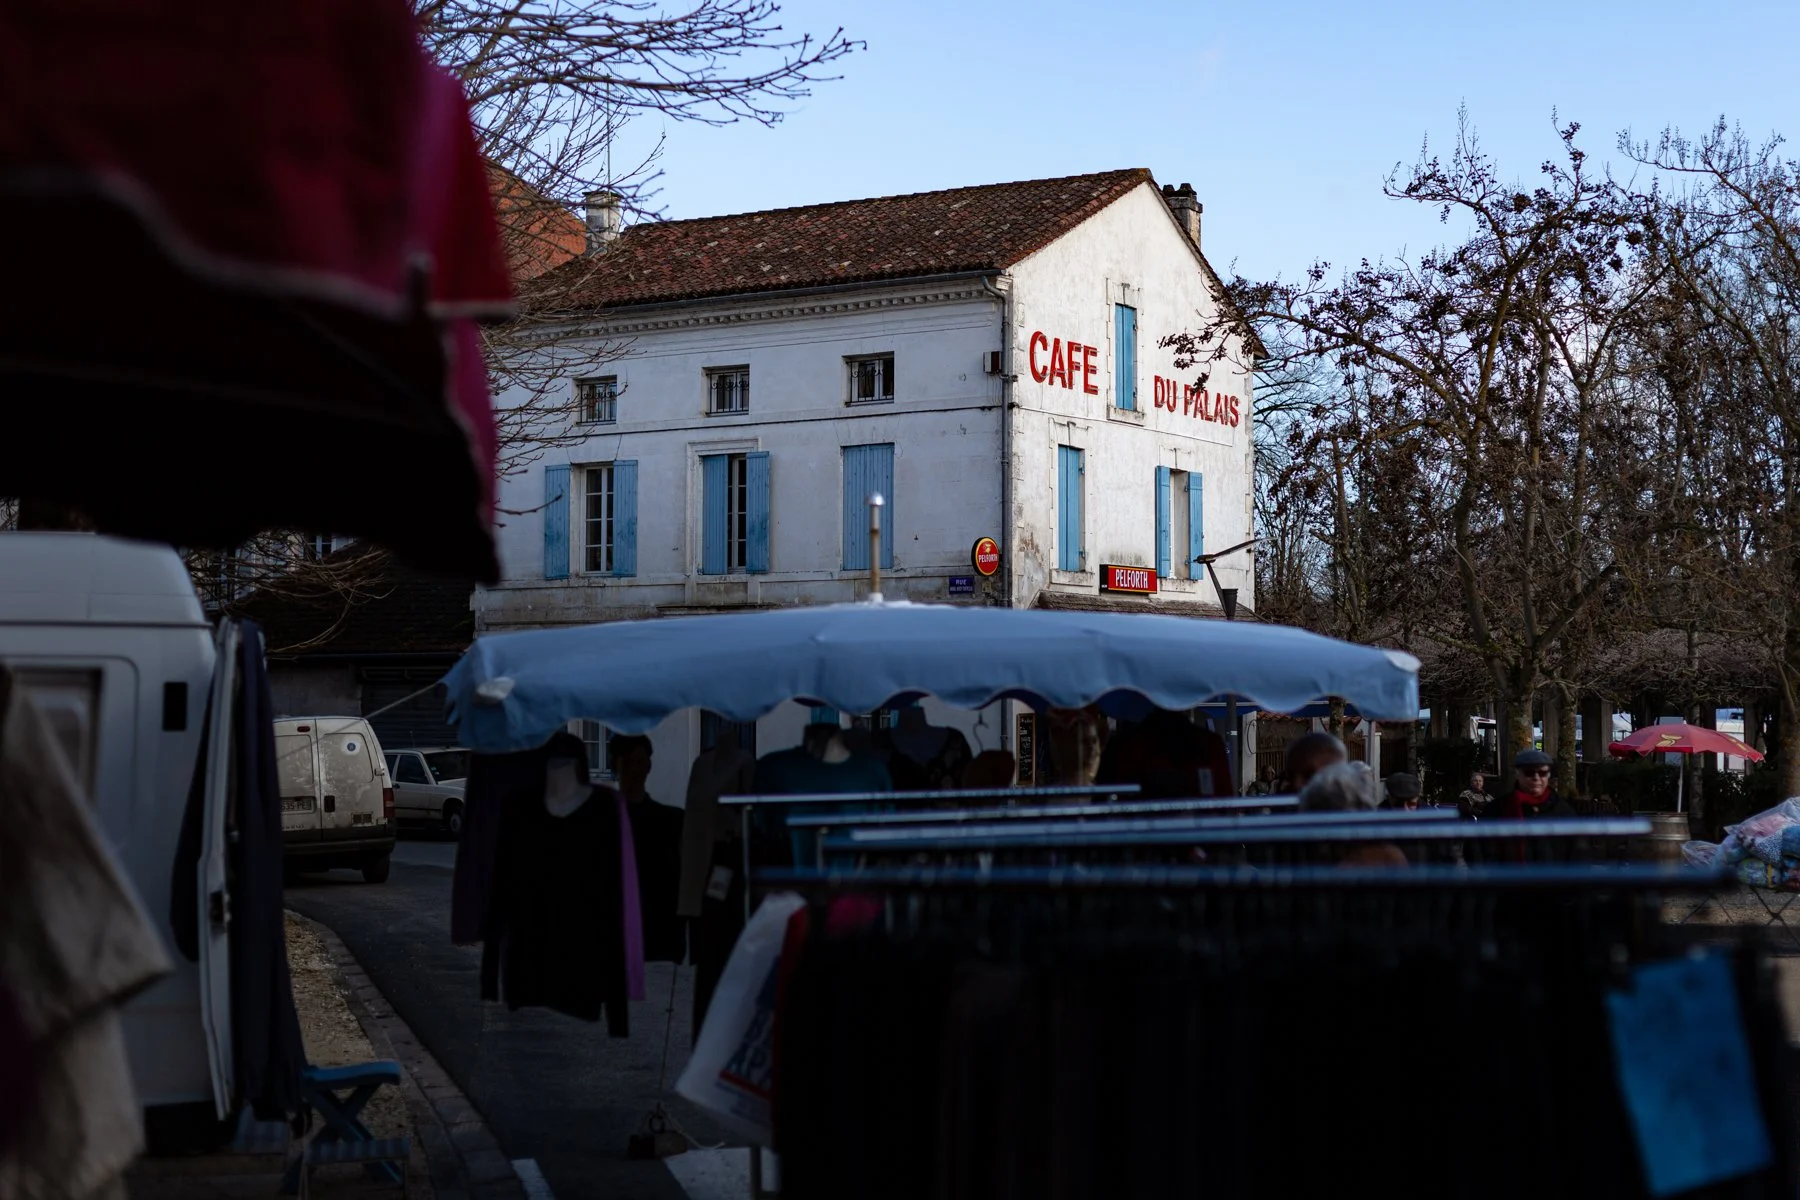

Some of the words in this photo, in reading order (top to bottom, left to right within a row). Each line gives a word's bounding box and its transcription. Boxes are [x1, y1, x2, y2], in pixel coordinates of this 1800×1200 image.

[1029, 331, 1098, 395] CAFE
[1153, 375, 1177, 412] DU
[1183, 383, 1240, 428] PALAIS
[978, 553, 998, 563] PELFORTH
[1115, 569, 1148, 589] PELFORTH
